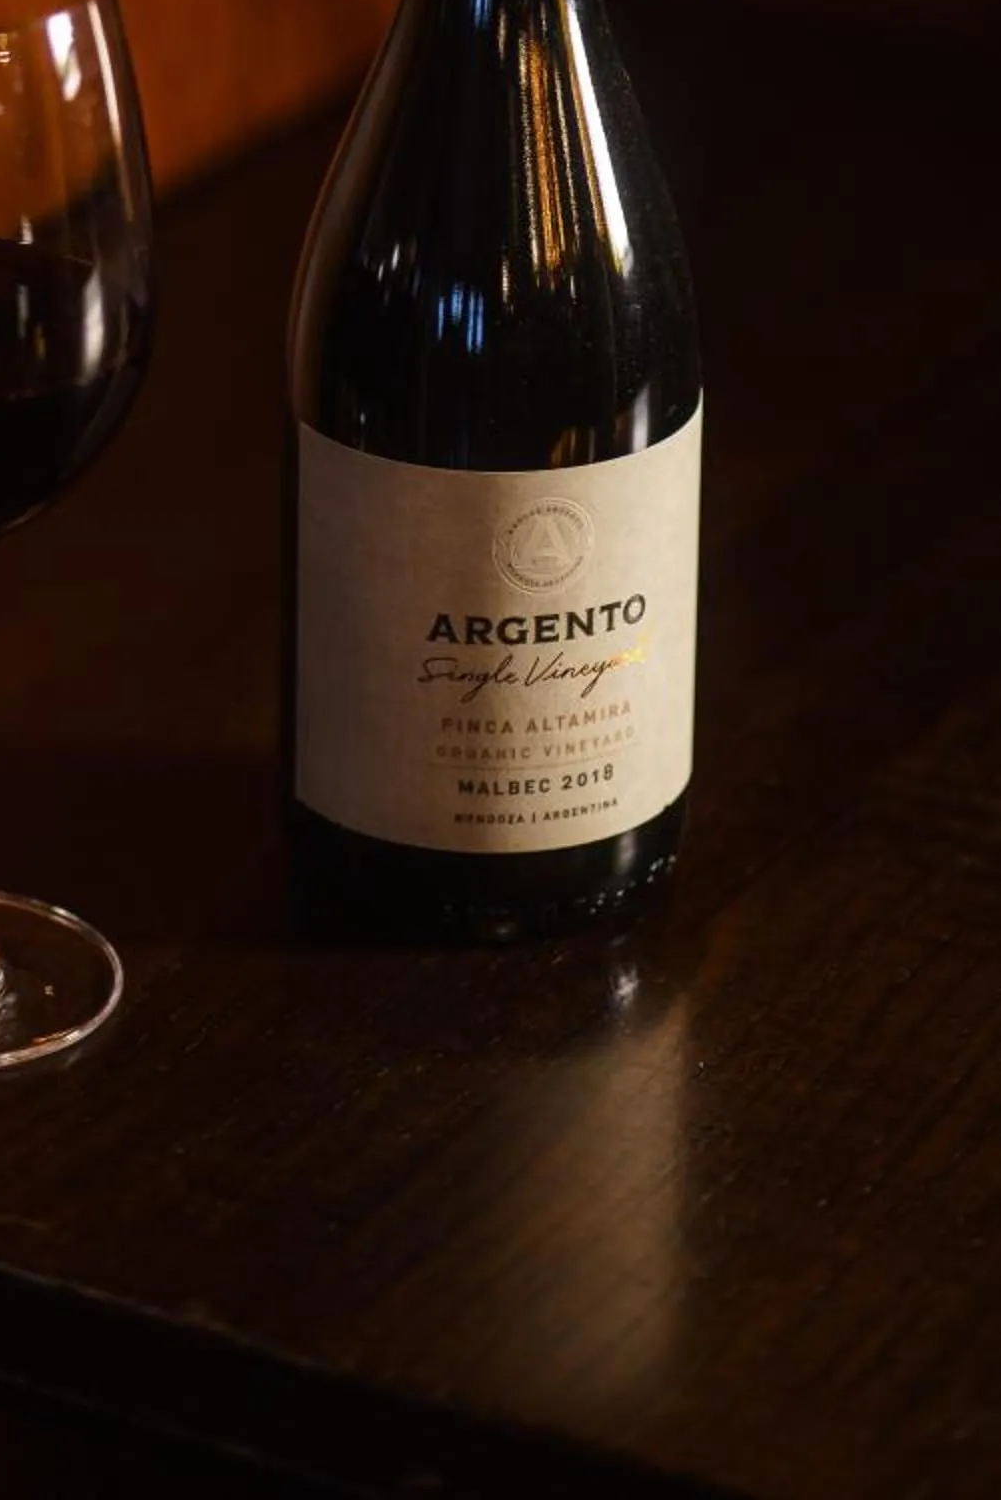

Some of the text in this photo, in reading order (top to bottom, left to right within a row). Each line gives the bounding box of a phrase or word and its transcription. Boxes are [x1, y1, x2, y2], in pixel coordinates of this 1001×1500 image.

[426, 593, 647, 646] ARGENTO
[418, 638, 646, 703] Single Vineya
[441, 700, 631, 735] FINCA ALTAMIRA
[435, 725, 635, 761] ORGANIC VINEYARD
[457, 762, 614, 797] MALBEC 2018
[454, 812, 525, 825] MENDOZA
[543, 797, 619, 821] ARGENTINA
